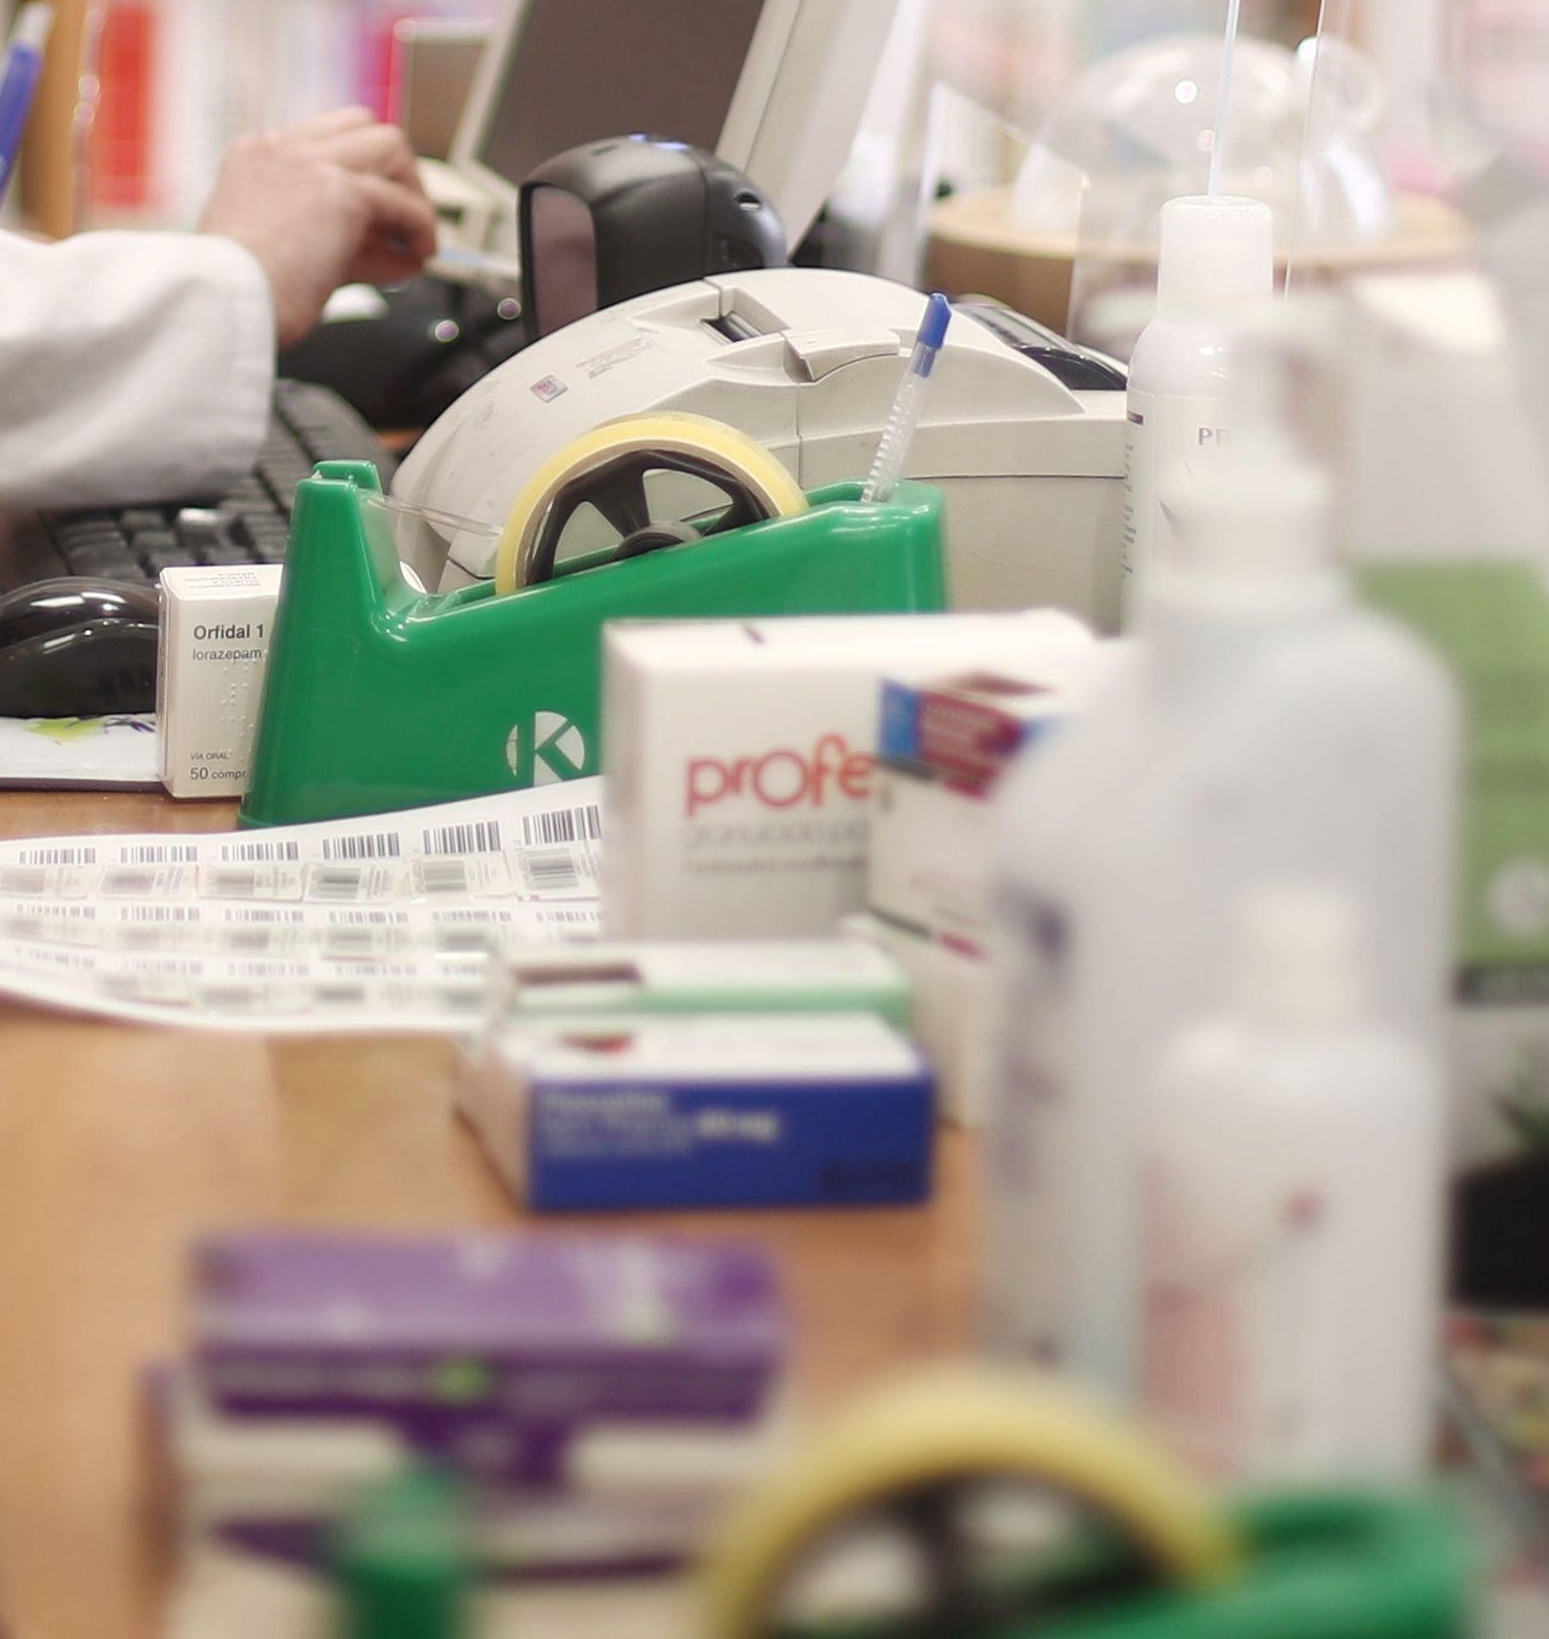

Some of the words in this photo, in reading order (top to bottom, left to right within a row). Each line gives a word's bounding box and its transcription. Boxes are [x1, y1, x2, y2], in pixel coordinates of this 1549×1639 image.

[193, 623, 251, 640] Orfidal
[256, 623, 264, 639] 1
[192, 647, 262, 664] lorazepam
[190, 766, 209, 780] 50
